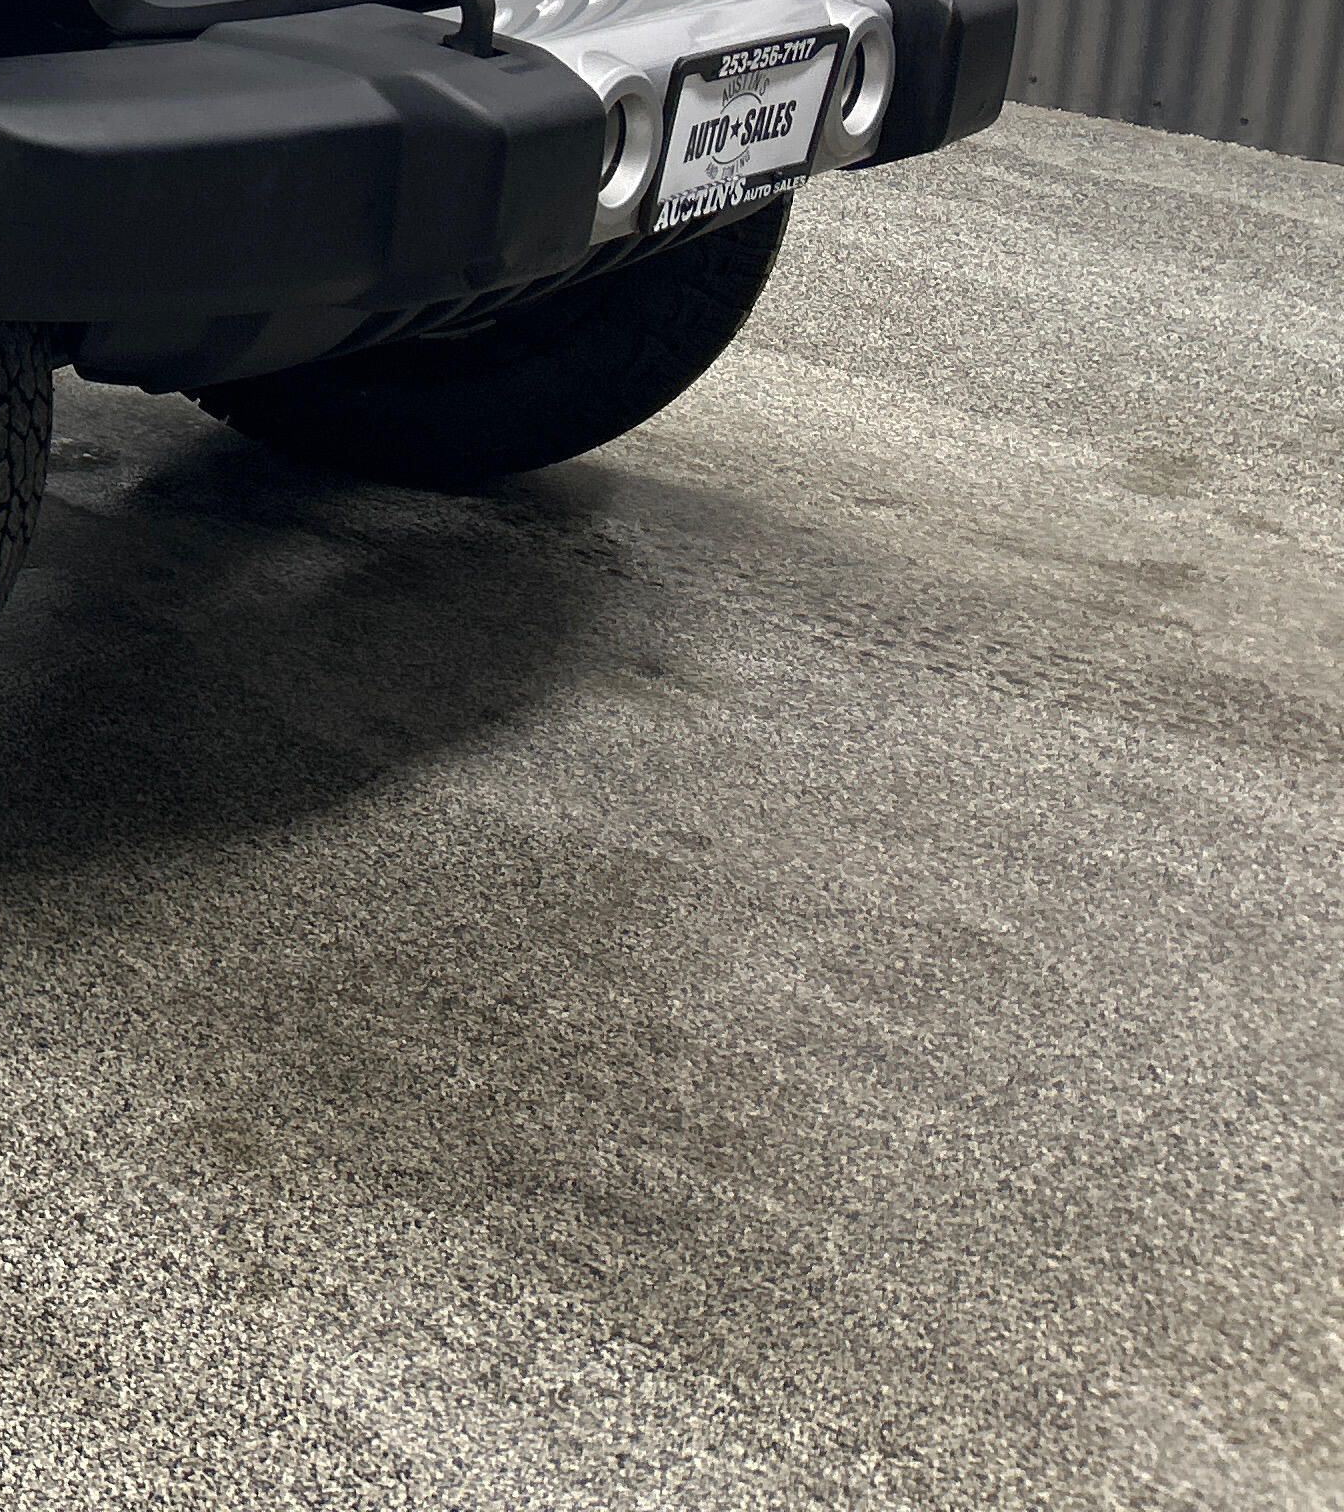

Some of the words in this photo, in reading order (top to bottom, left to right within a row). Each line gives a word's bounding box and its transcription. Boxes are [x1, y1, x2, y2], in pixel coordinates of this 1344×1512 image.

[719, 38, 816, 77] 253-256-7117
[684, 115, 730, 163] AUTO
[740, 100, 797, 146] SALES
[653, 176, 747, 233] AUSTIN'S
[744, 184, 771, 201] AUTO
[773, 175, 808, 195] SALES
